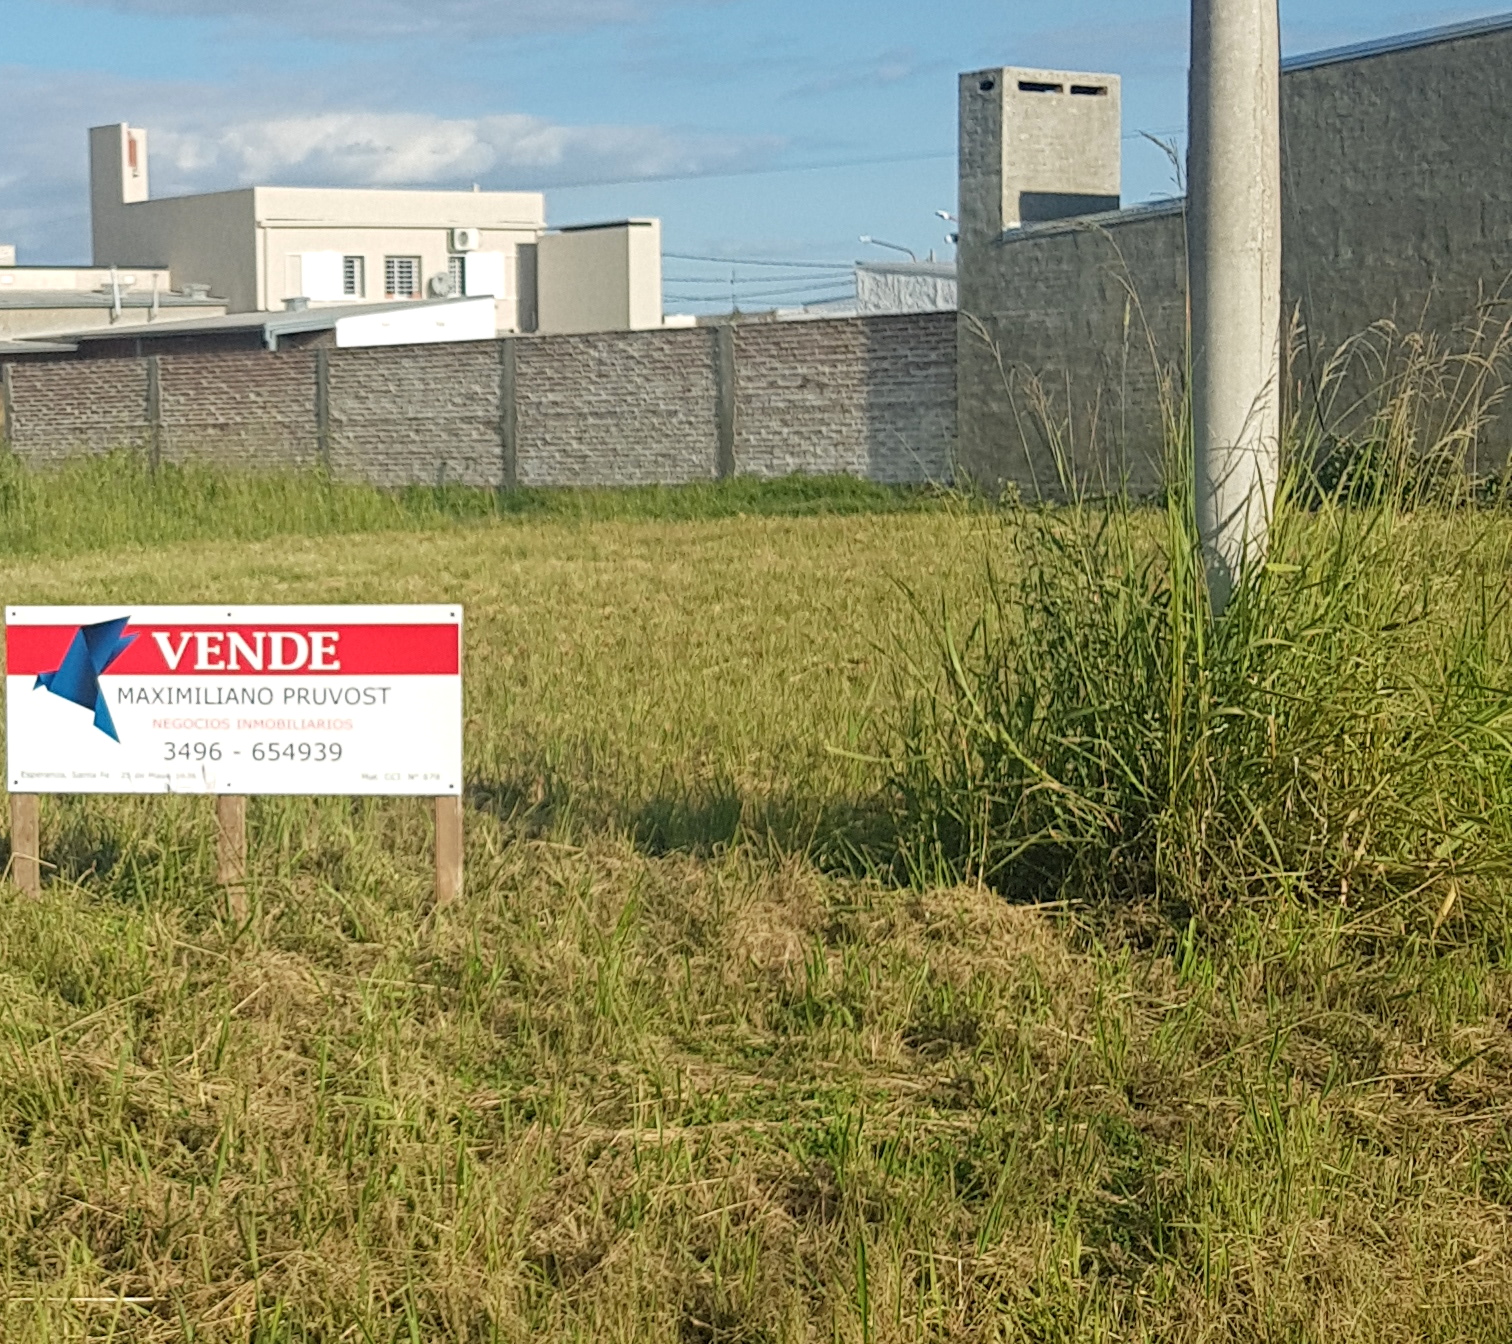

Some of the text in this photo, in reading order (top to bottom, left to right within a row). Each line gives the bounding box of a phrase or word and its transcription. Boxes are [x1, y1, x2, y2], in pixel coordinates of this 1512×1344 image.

[151, 631, 341, 671] VENDE
[117, 686, 391, 706] MAXIMILIANO PRUVOST
[152, 717, 354, 731] NEGOCIOS INMOBILIARIOS
[163, 741, 223, 762] 3496
[251, 741, 344, 762] 654939
